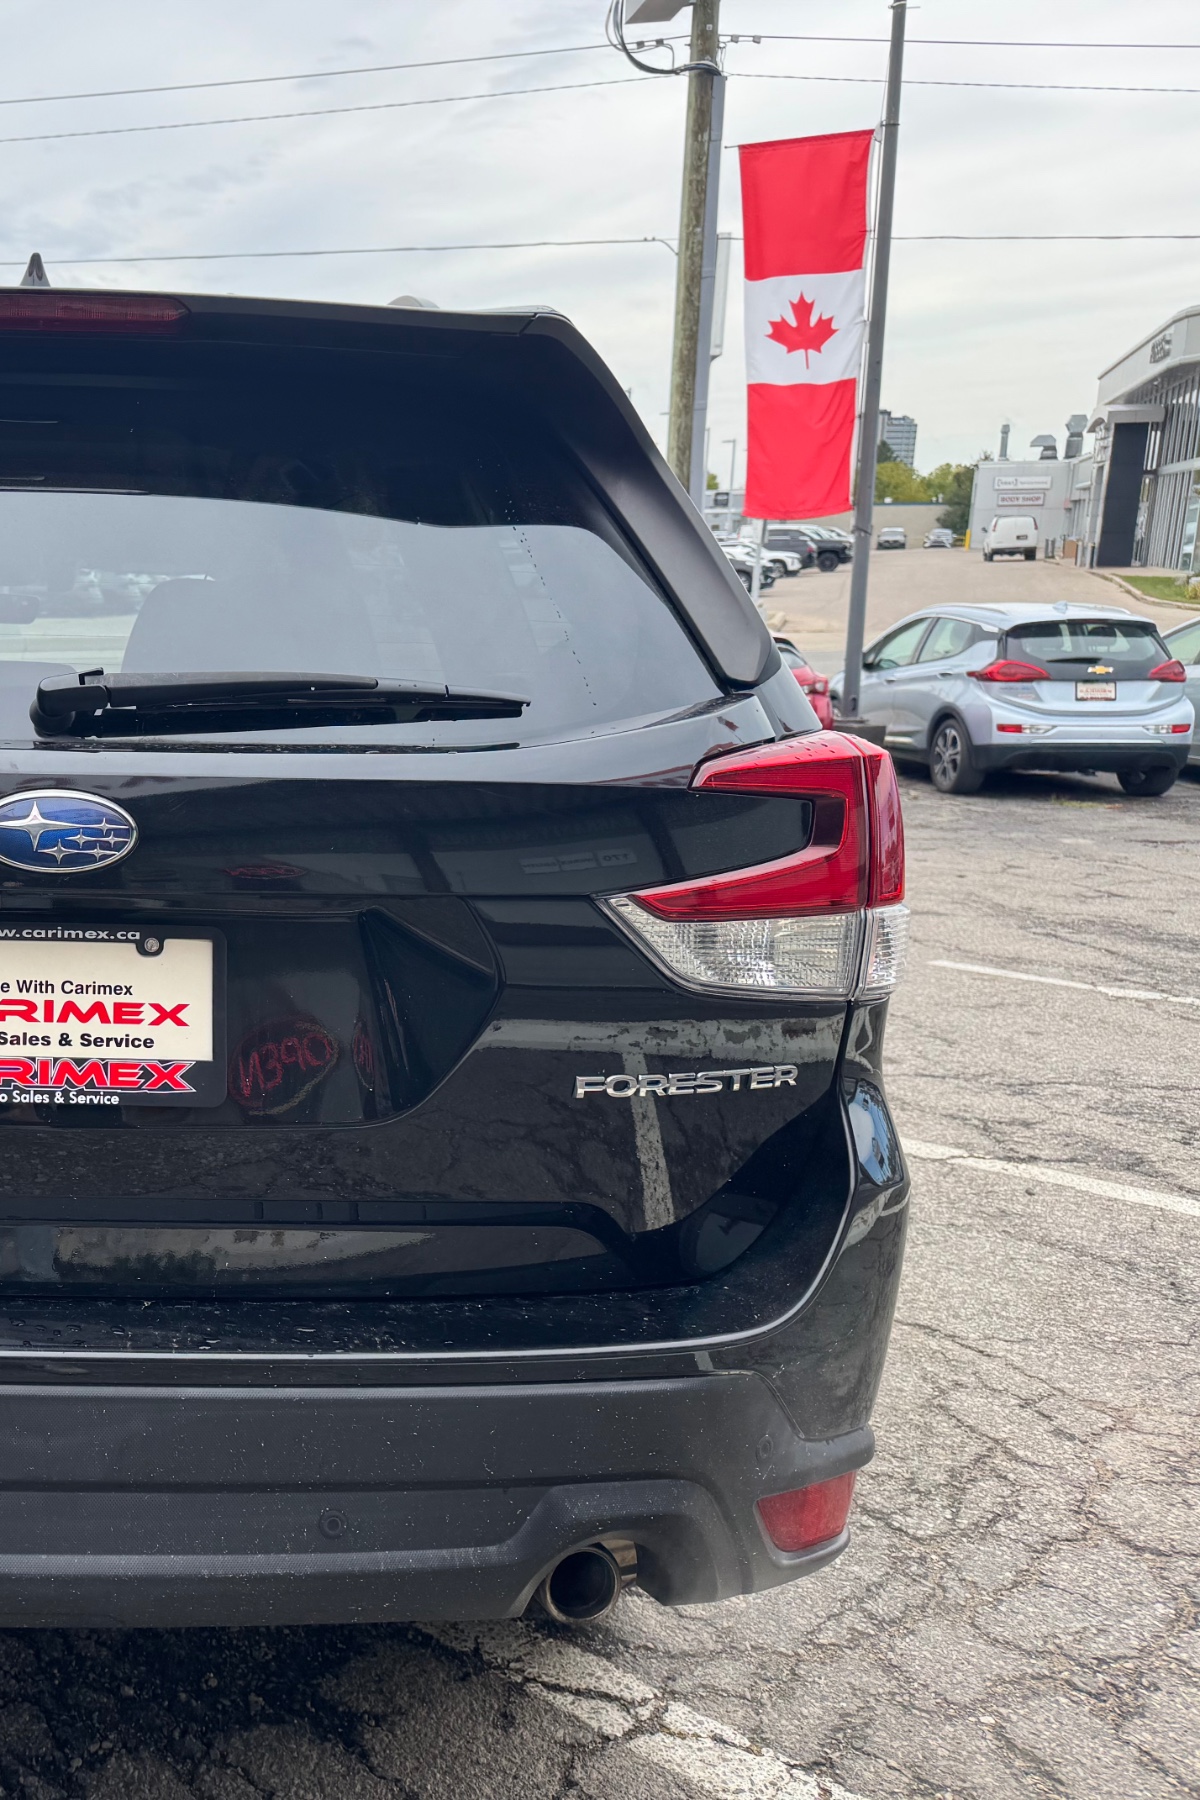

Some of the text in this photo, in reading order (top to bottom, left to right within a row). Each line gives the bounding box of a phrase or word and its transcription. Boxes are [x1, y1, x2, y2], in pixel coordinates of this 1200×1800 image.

[16, 979, 55, 994] With
[61, 980, 133, 996] Carimex
[58, 1033, 73, 1047] &
[80, 1033, 154, 1048] Service
[574, 1064, 798, 1099] FORESTER
[12, 1090, 49, 1104] Sales
[54, 1091, 65, 1104] &
[69, 1091, 120, 1105] Service
